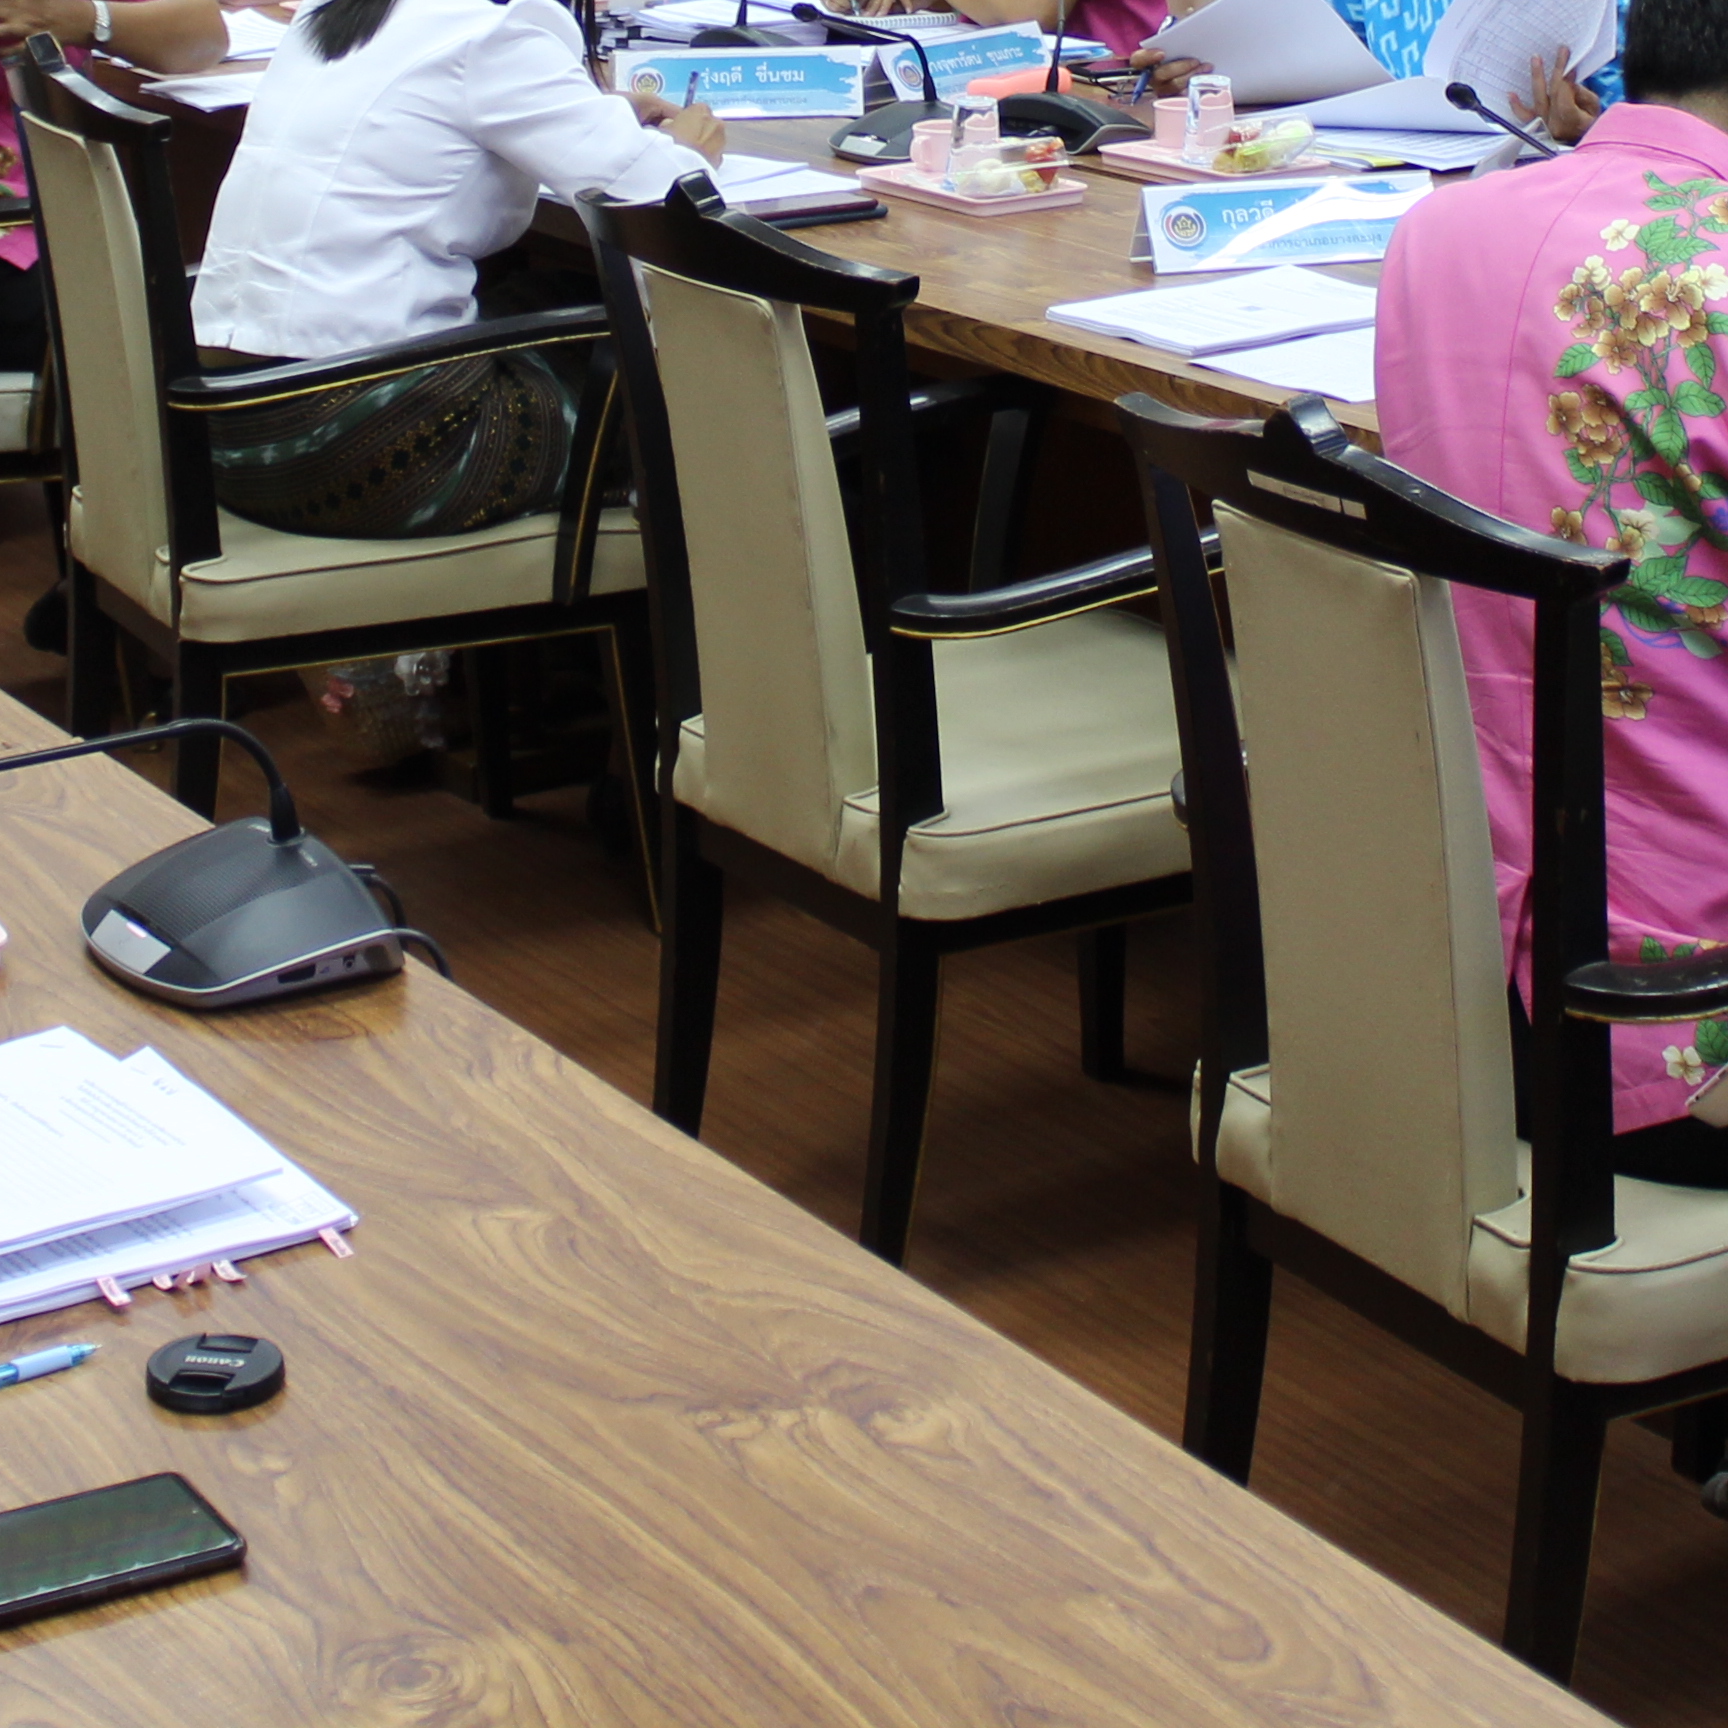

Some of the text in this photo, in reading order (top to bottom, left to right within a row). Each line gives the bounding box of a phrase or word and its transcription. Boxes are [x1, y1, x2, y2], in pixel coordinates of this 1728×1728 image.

[700, 62, 804, 88] รุ่งฤดี ชื่นชม
[184, 1354, 246, 1368] Canon
